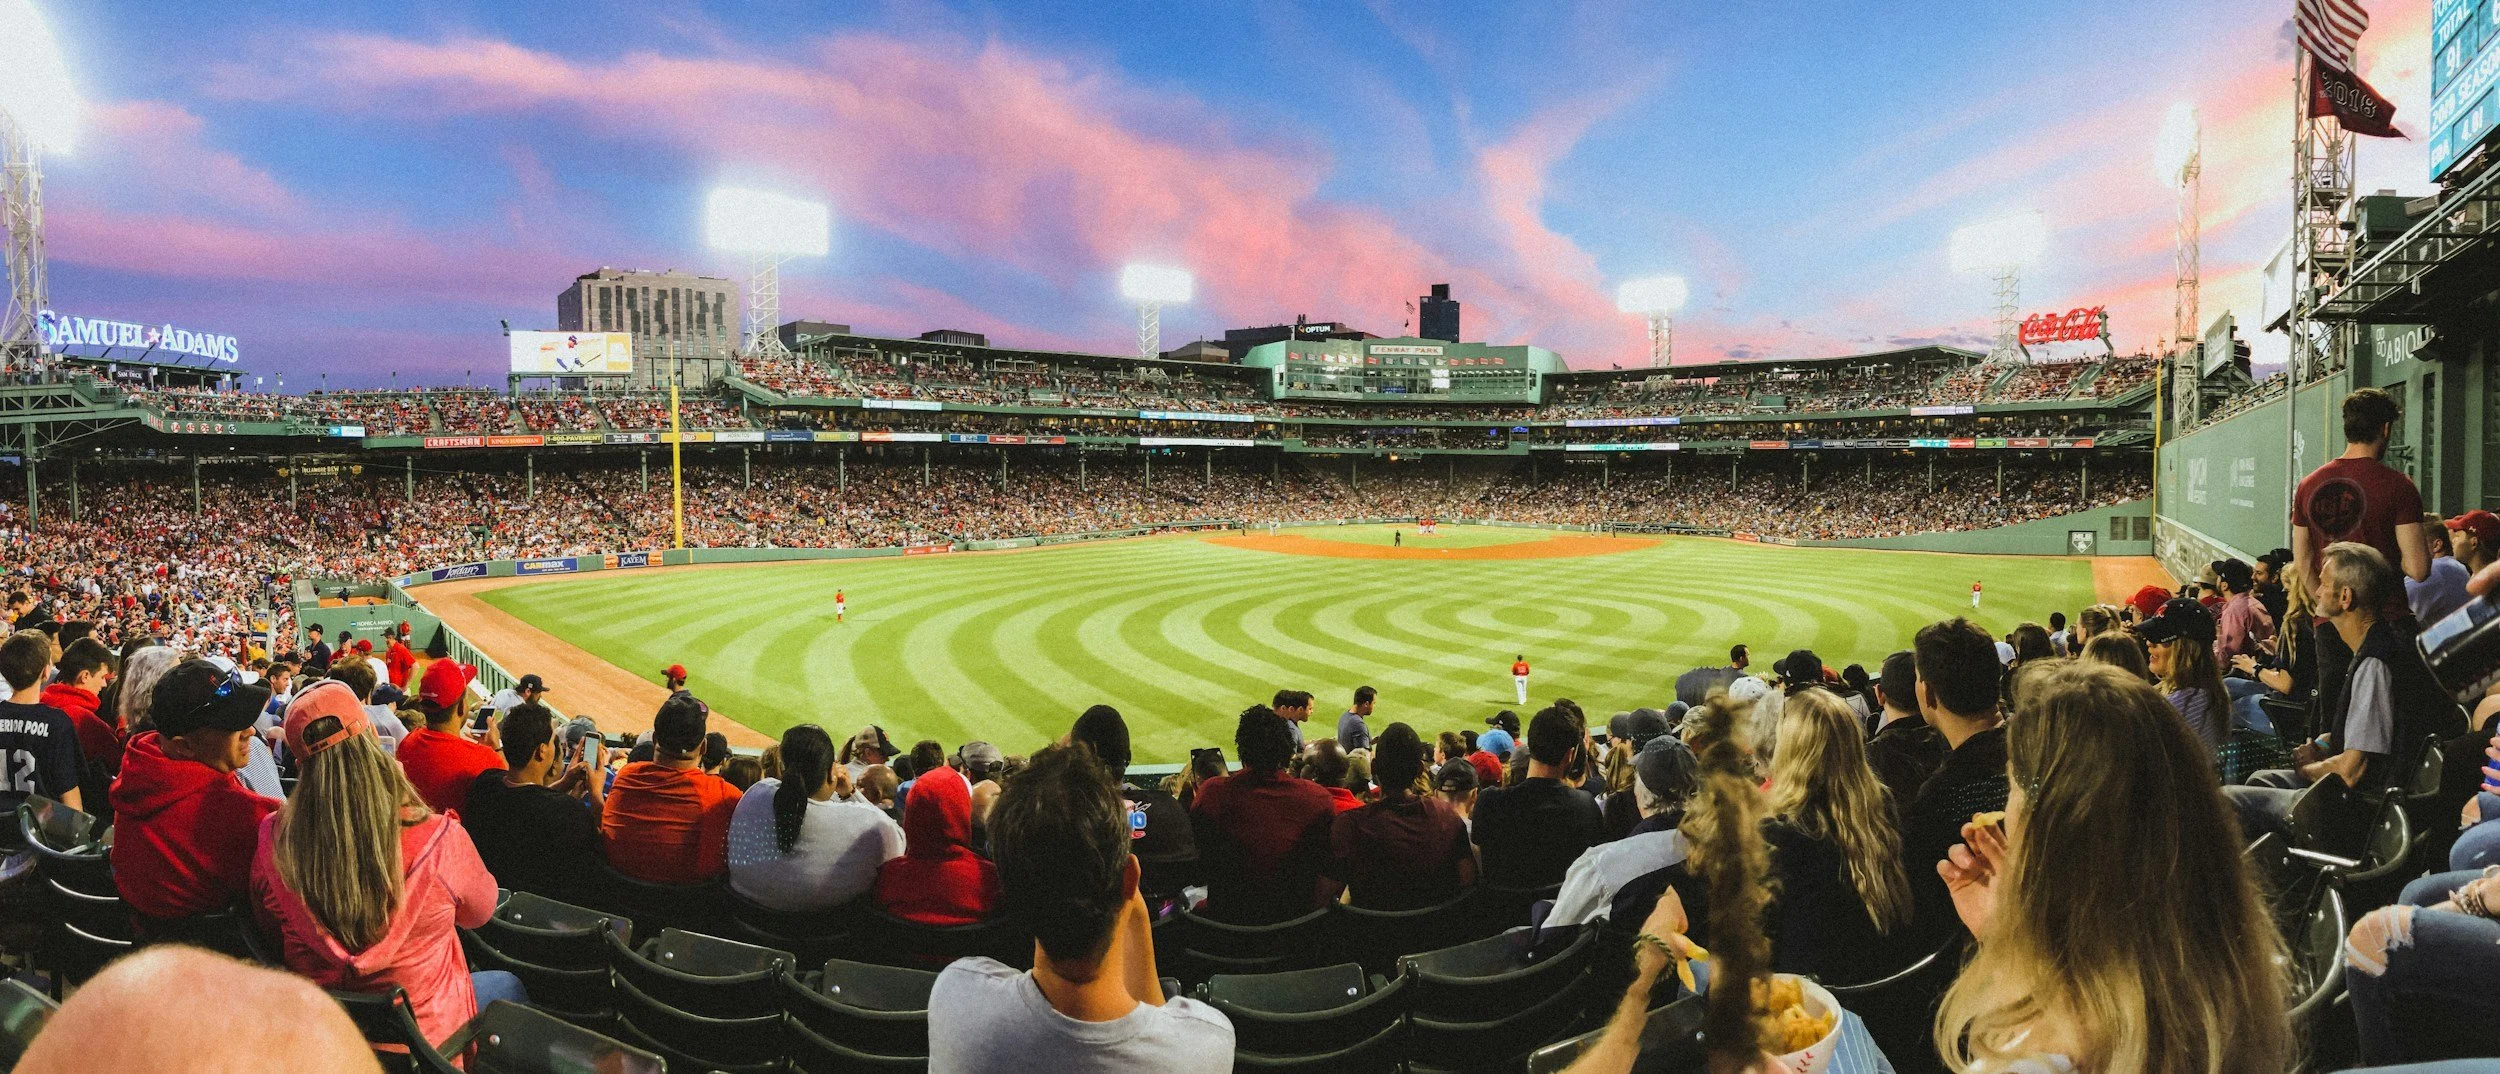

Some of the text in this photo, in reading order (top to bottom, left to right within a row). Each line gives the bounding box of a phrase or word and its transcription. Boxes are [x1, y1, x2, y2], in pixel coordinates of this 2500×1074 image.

[2438, 0, 2471, 46] TOTAL
[2447, 37, 2461, 77] 91
[2321, 71, 2377, 118] 2018
[1305, 325, 1331, 334] OPTUM
[2019, 305, 2105, 345] Coca-Cola
[159, 323, 239, 363] ADAMS
[1374, 346, 1410, 354] FENWAY
[427, 437, 481, 447] CRAFTSMAN
[445, 564, 480, 579] Jordan's
[620, 555, 647, 567] KAYEM
[24, 720, 49, 737] POOL
[0, 749, 36, 795] 12
